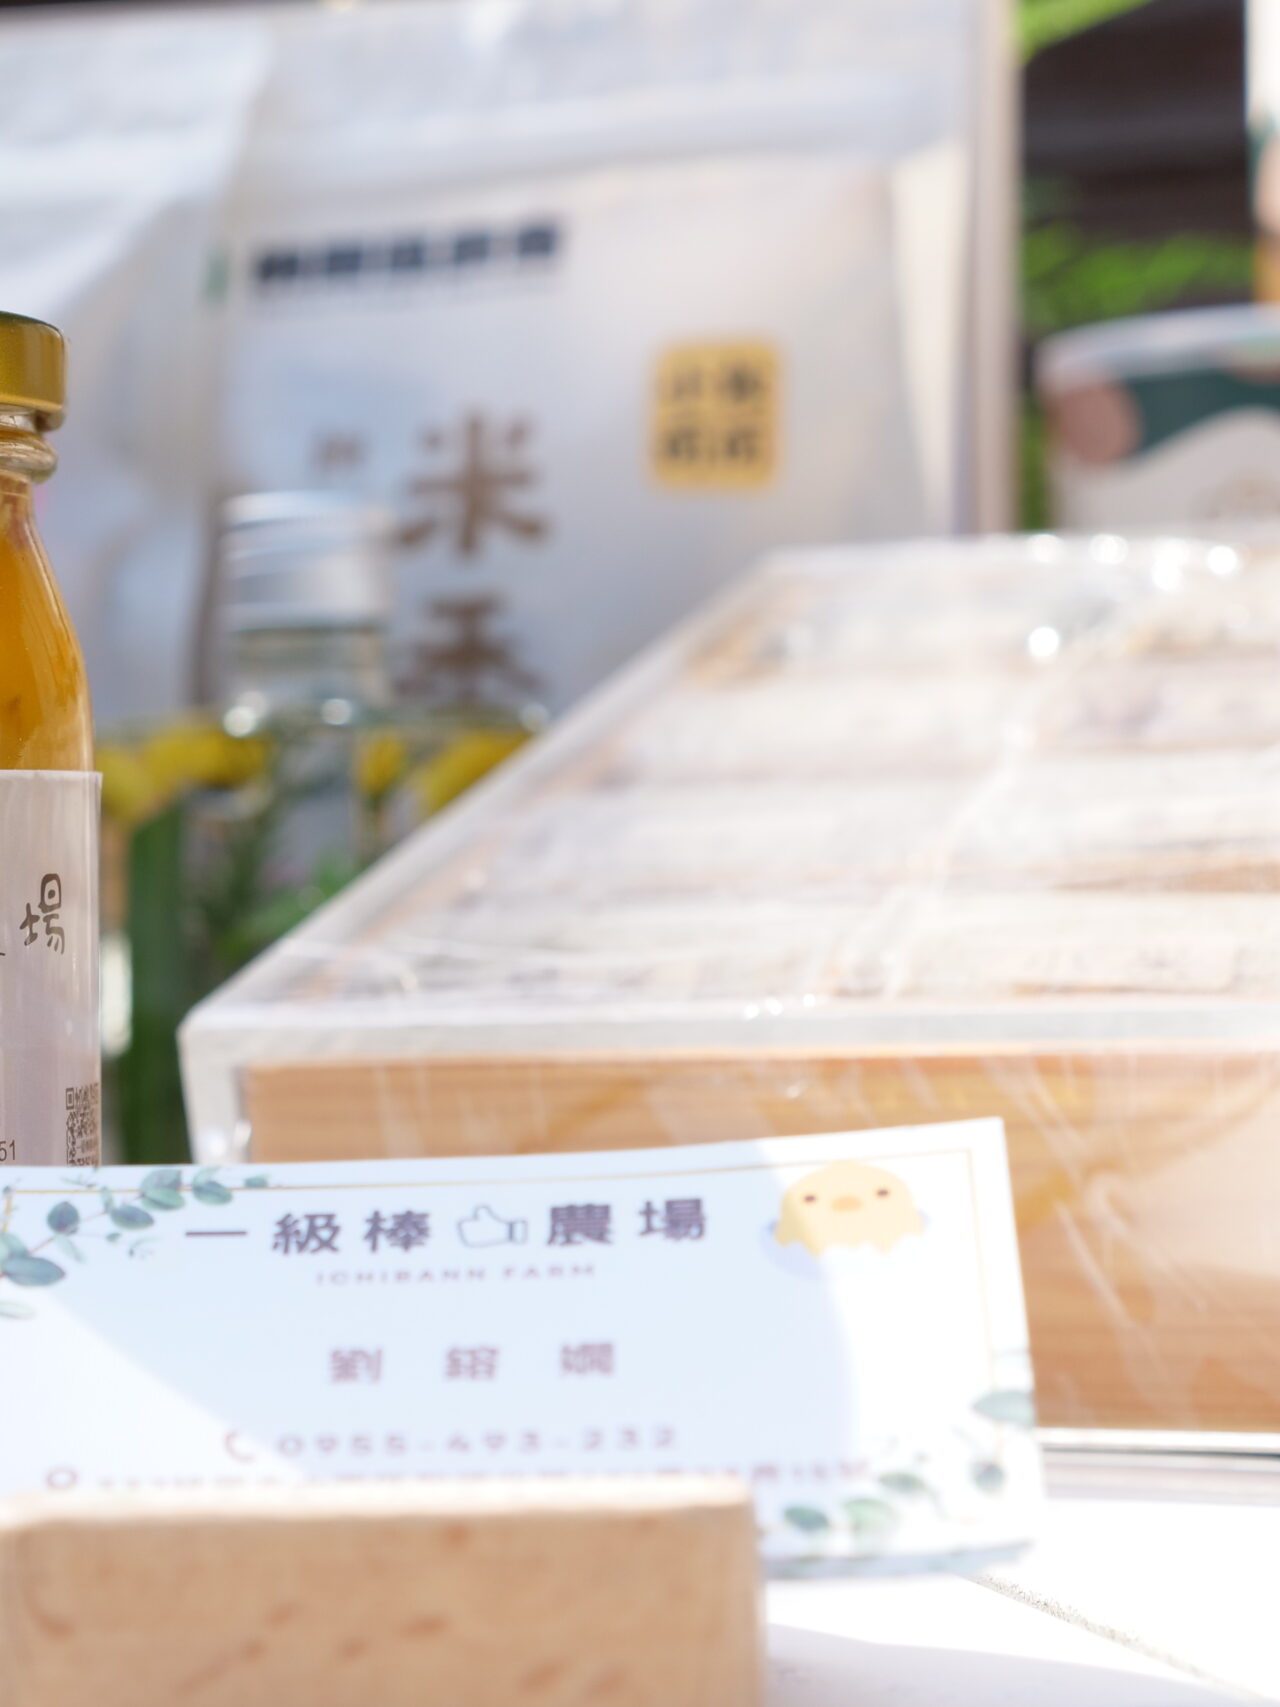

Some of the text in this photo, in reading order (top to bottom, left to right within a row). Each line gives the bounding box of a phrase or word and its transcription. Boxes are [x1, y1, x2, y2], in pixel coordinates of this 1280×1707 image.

[185, 1197, 707, 1256] 一級棒 農場
[502, 1261, 596, 1280] FARM
